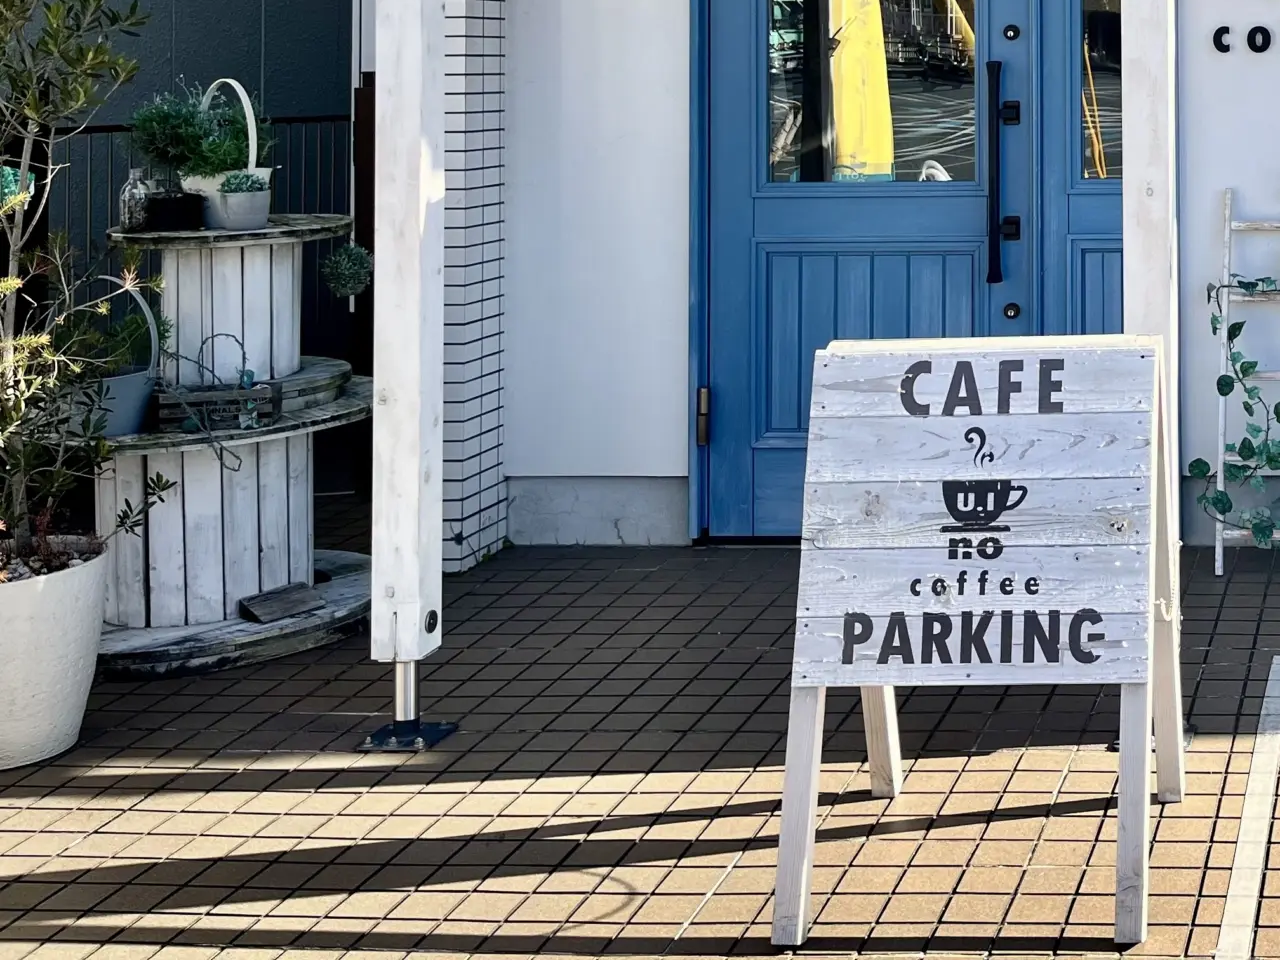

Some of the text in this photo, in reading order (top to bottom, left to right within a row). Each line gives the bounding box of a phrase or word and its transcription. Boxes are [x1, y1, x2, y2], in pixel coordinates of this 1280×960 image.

[900, 358, 1065, 417] CAFE
[948, 536, 1004, 560] no
[910, 570, 1040, 597] coffee
[841, 608, 1106, 665] PARKING
